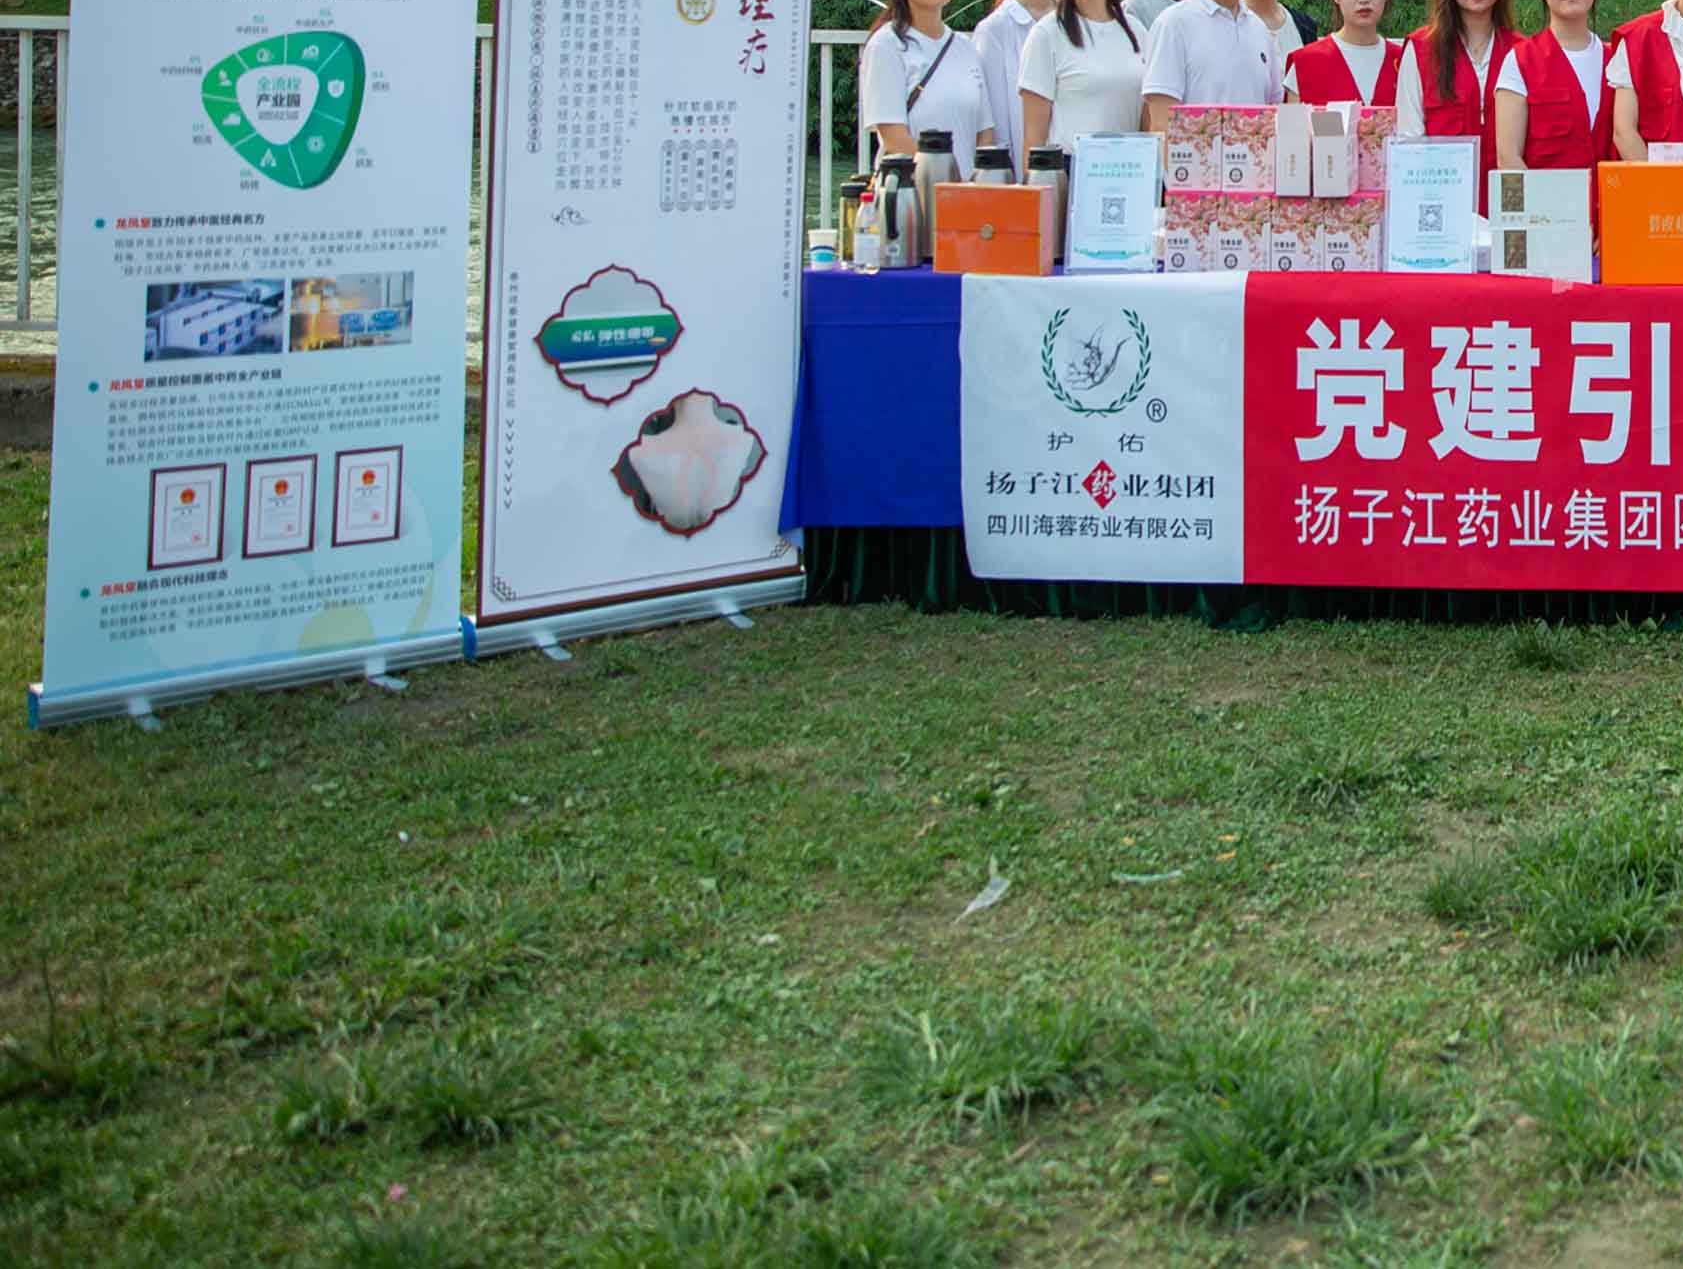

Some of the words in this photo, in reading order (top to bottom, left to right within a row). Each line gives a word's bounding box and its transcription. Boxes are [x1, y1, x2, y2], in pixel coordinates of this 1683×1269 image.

[986, 468, 1216, 502] 扬子江药业集团
[987, 514, 1213, 540] 四川海蓉药业有限公司
